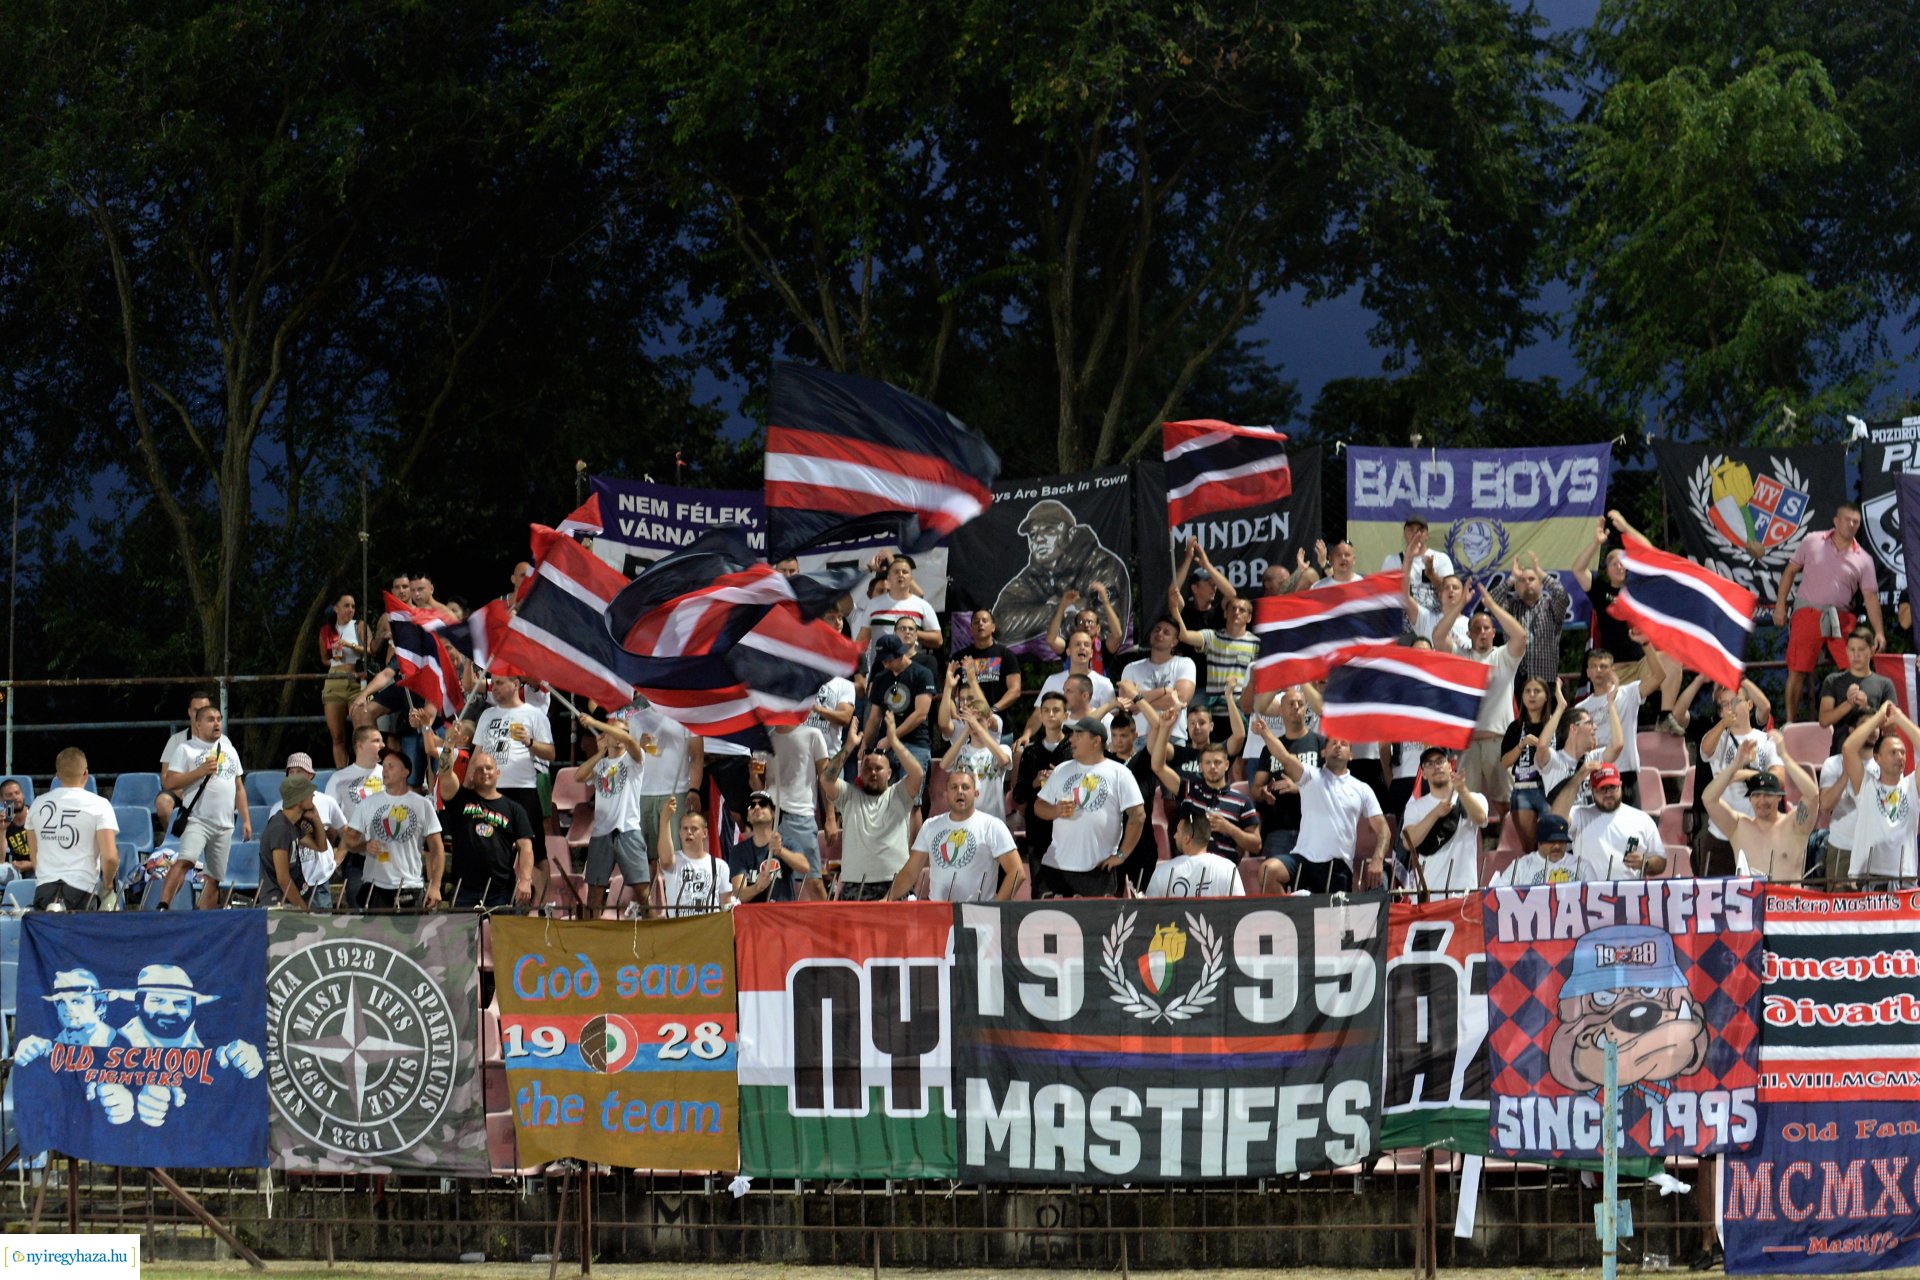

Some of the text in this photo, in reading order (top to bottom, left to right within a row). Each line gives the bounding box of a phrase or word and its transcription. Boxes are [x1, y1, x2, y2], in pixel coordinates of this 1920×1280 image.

[1013, 488, 1037, 500] Are
[1041, 482, 1074, 497] Back
[1077, 480, 1090, 492] In
[1094, 473, 1128, 489] Town
[1354, 456, 1599, 510] BAD BOYS
[1753, 481, 1801, 517] NY S
[618, 493, 758, 529] NEM FÉLEK,
[618, 517, 705, 547] VÁRNA
[1171, 511, 1290, 552] MINDEN
[1770, 522, 1787, 541] C
[39, 800, 81, 850] 25
[1498, 879, 1756, 942] MASTIFFS
[1766, 895, 1830, 914] Eastern
[1832, 894, 1901, 913] Mastiffs
[325, 946, 376, 971] 1928
[513, 953, 723, 1001] God save
[962, 901, 1381, 1024] 19 95
[1762, 949, 1920, 984] imentü
[293, 983, 413, 1037] MAST IFFS
[410, 981, 452, 1115] SPARTACUS
[503, 1021, 728, 1061] 19 28
[50, 1043, 214, 1086] OLD SCHOOL
[84, 1069, 185, 1087] FIGHTERS
[294, 1056, 419, 1117] 1995 SINCE
[516, 1080, 721, 1133] the team
[331, 1126, 384, 1150] 1928
[965, 1077, 1372, 1178] MASTIFFS
[1645, 1087, 1758, 1149] 1995
[1782, 1121, 1839, 1143] Old
[1806, 1231, 1899, 1256] Mastiffs
